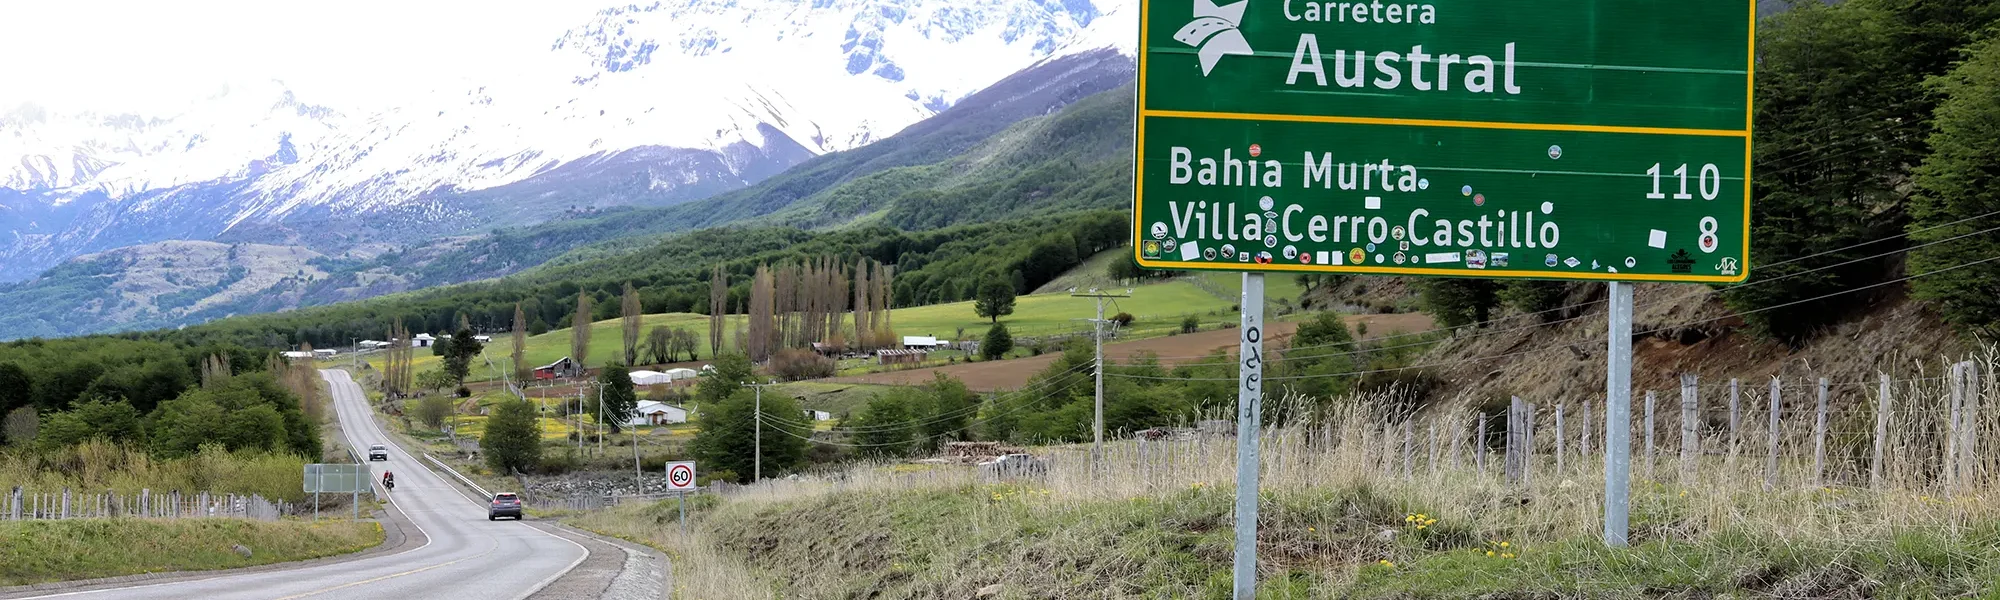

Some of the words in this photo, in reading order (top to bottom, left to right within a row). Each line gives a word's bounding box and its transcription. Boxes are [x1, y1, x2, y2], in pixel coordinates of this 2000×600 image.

[1283, 0, 1436, 24] Carretera
[1285, 33, 1521, 95] Austral
[1303, 151, 1417, 192] Murta
[1646, 162, 1720, 201] 110
[1168, 200, 1262, 241] Villa
[1282, 203, 1388, 244] Cerro
[1407, 208, 1560, 249] Castillo
[1698, 216, 1719, 254] 8
[673, 470, 688, 481] 60
